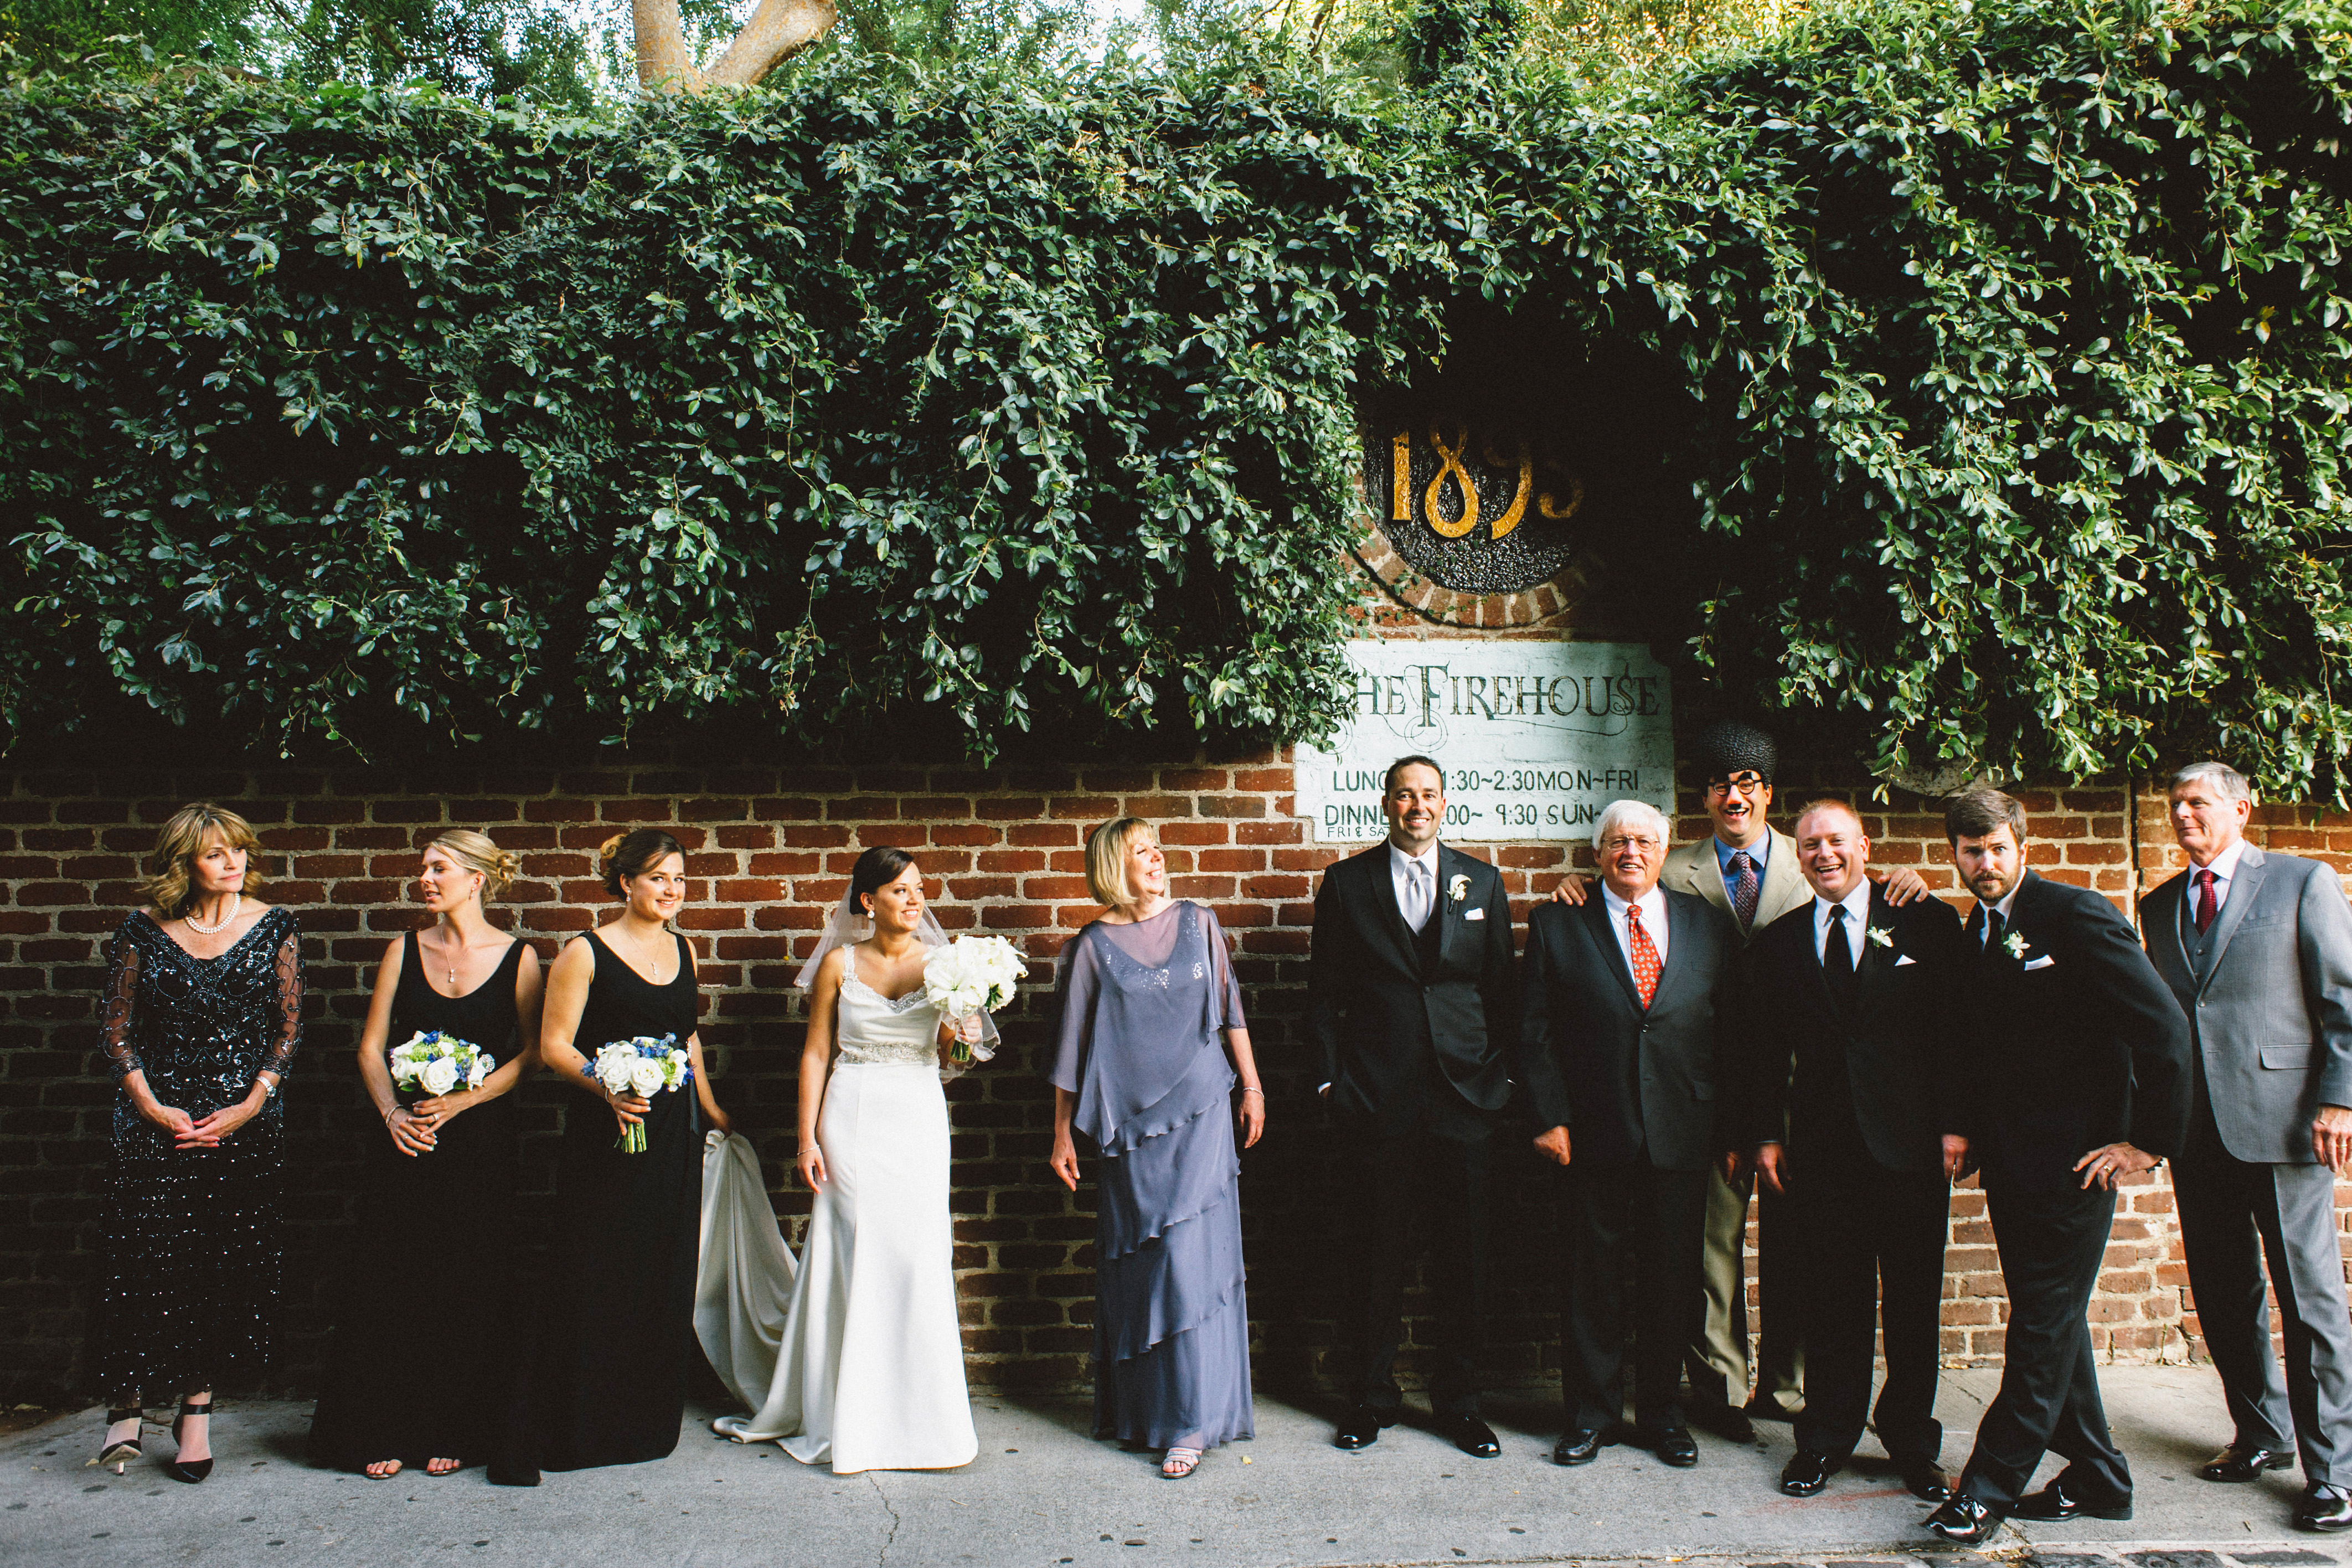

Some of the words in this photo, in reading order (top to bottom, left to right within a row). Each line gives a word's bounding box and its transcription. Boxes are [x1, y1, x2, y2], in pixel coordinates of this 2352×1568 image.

[1354, 675, 1405, 715] HE
[1405, 660, 1661, 731] FIREHOUSE
[1333, 770, 1388, 791] LUNC
[1325, 804, 1390, 826] DINNE
[1495, 804, 1537, 825] 9:30
[1328, 826, 1350, 838] FRI
